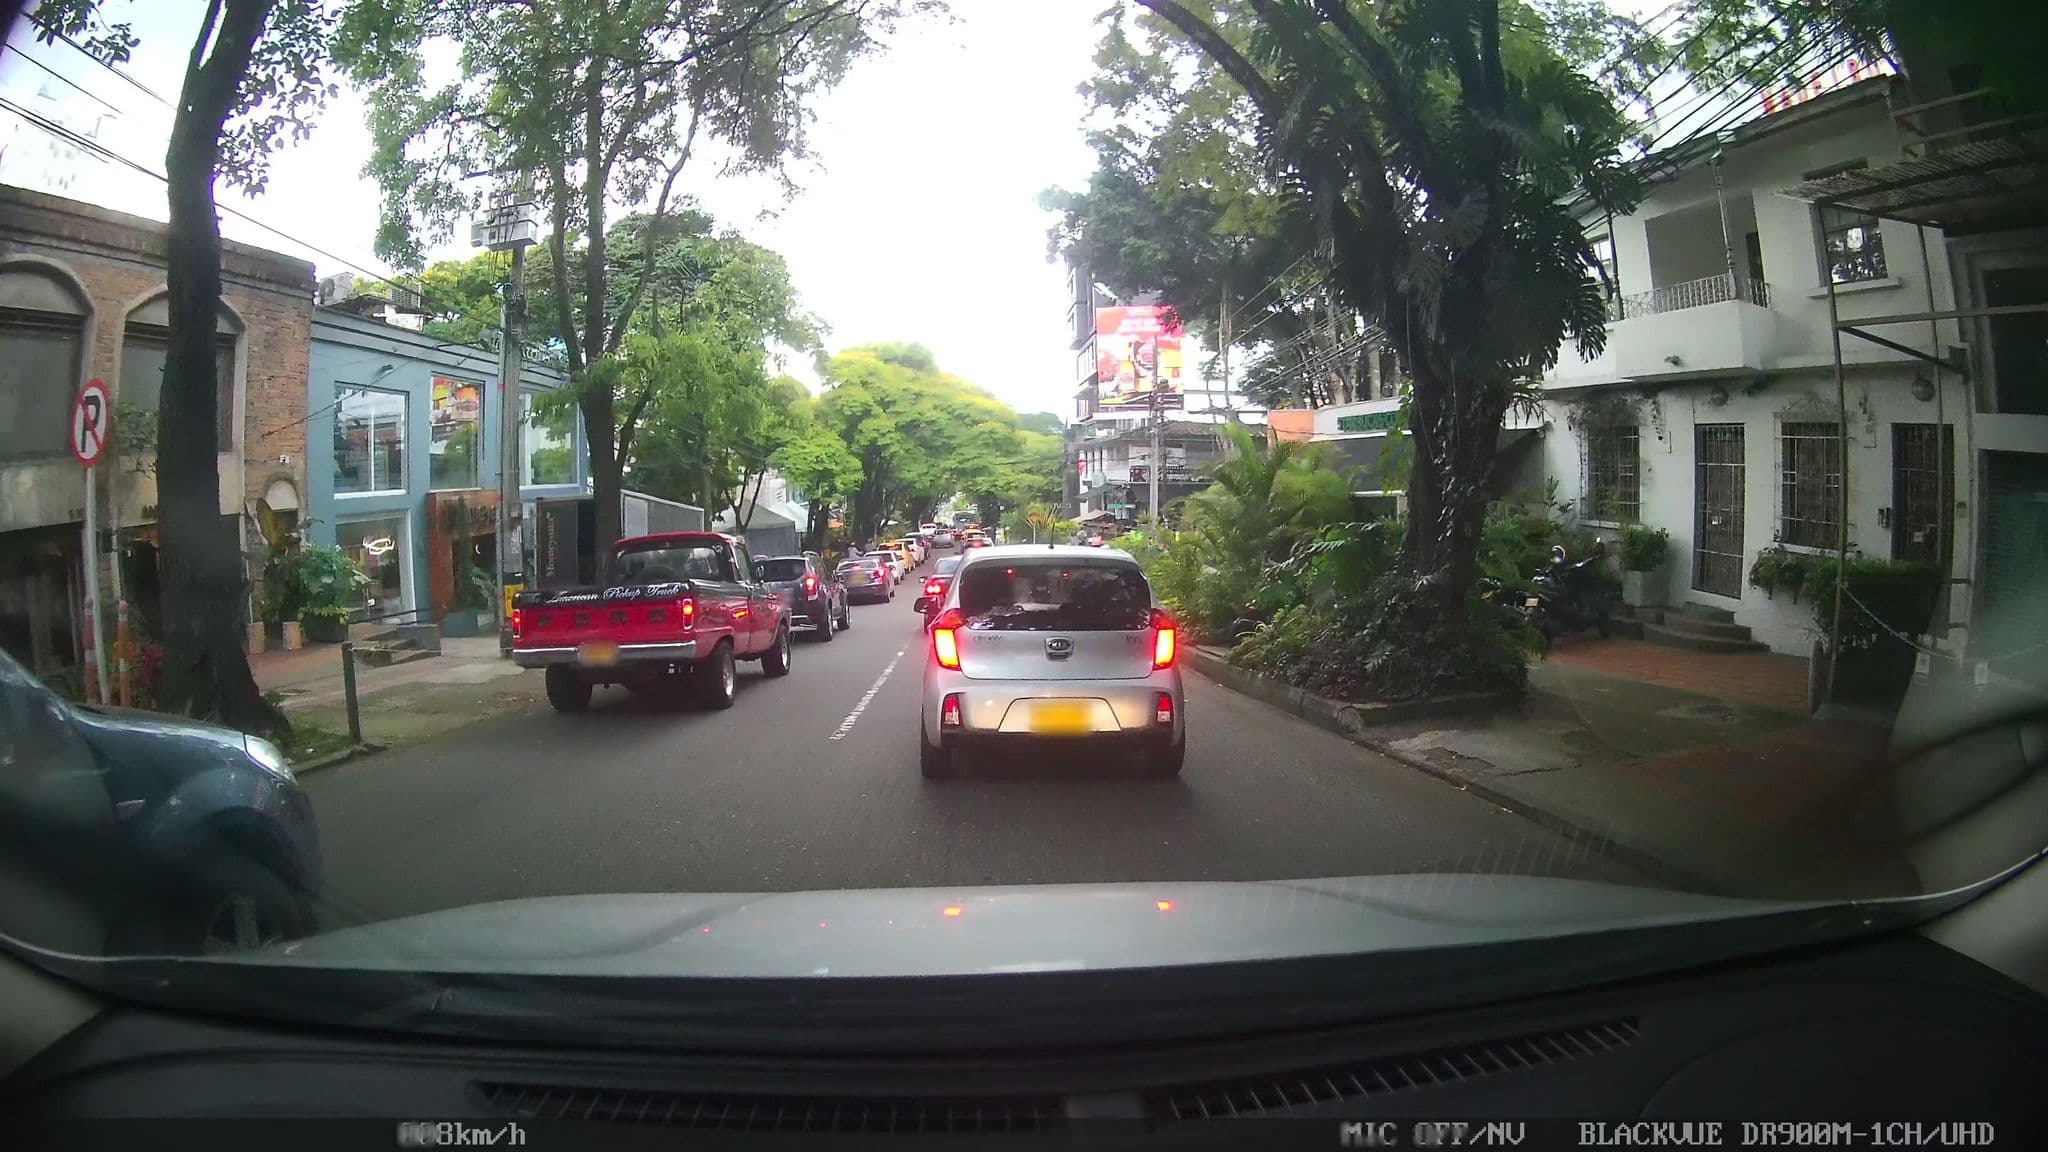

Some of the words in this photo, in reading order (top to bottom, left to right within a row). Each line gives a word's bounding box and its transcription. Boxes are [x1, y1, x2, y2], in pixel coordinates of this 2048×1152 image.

[546, 590, 598, 604] American
[602, 585, 641, 600] Pickup
[646, 583, 680, 597] Truck
